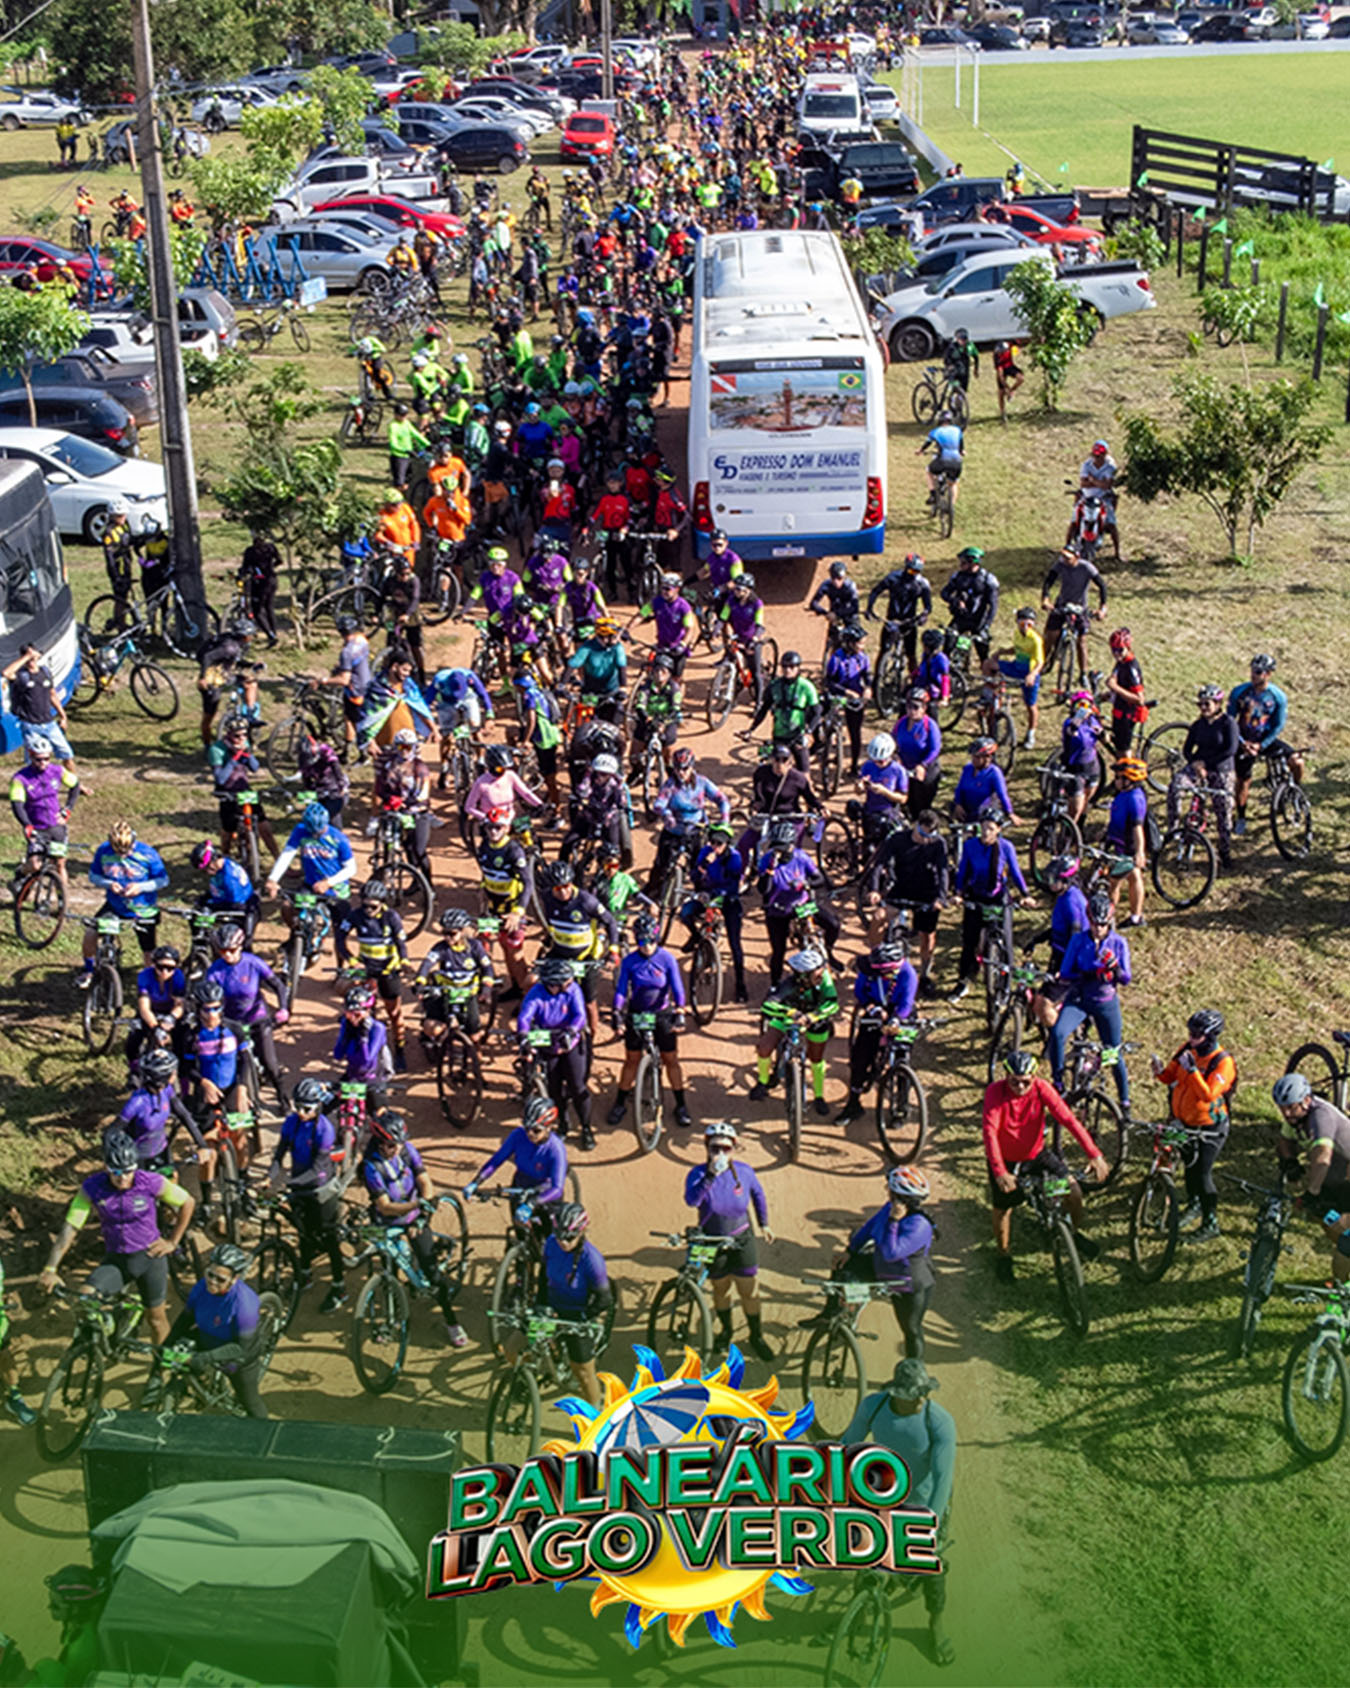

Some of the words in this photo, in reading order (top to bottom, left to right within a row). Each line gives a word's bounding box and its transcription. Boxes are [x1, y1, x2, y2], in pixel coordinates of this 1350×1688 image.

[740, 455, 787, 470] EXPRESSO
[790, 453, 814, 468] DOM
[817, 452, 861, 468] EMANUEL
